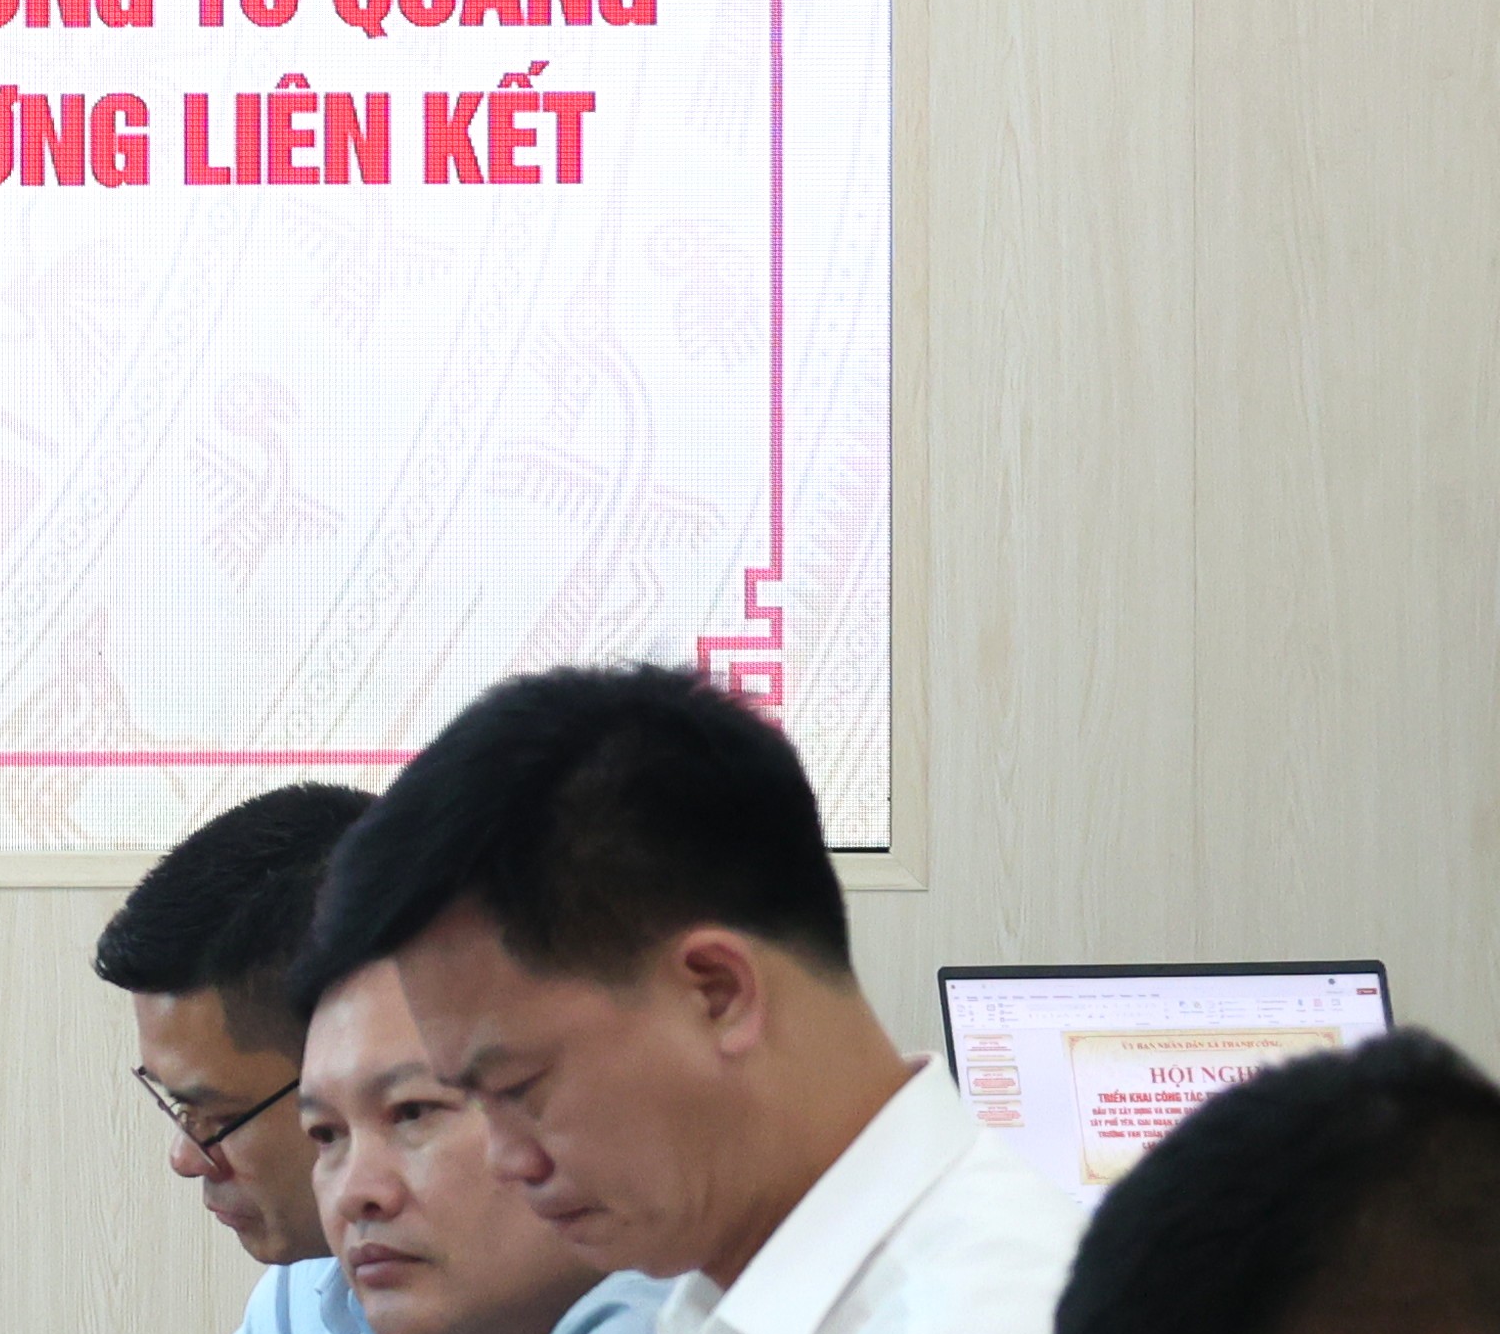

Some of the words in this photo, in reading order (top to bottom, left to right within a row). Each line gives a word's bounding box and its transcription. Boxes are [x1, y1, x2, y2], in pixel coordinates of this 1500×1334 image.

[184, 73, 391, 185] LIÊN
[424, 61, 596, 184] KẾT
[1201, 1065, 1258, 1085] NGH
